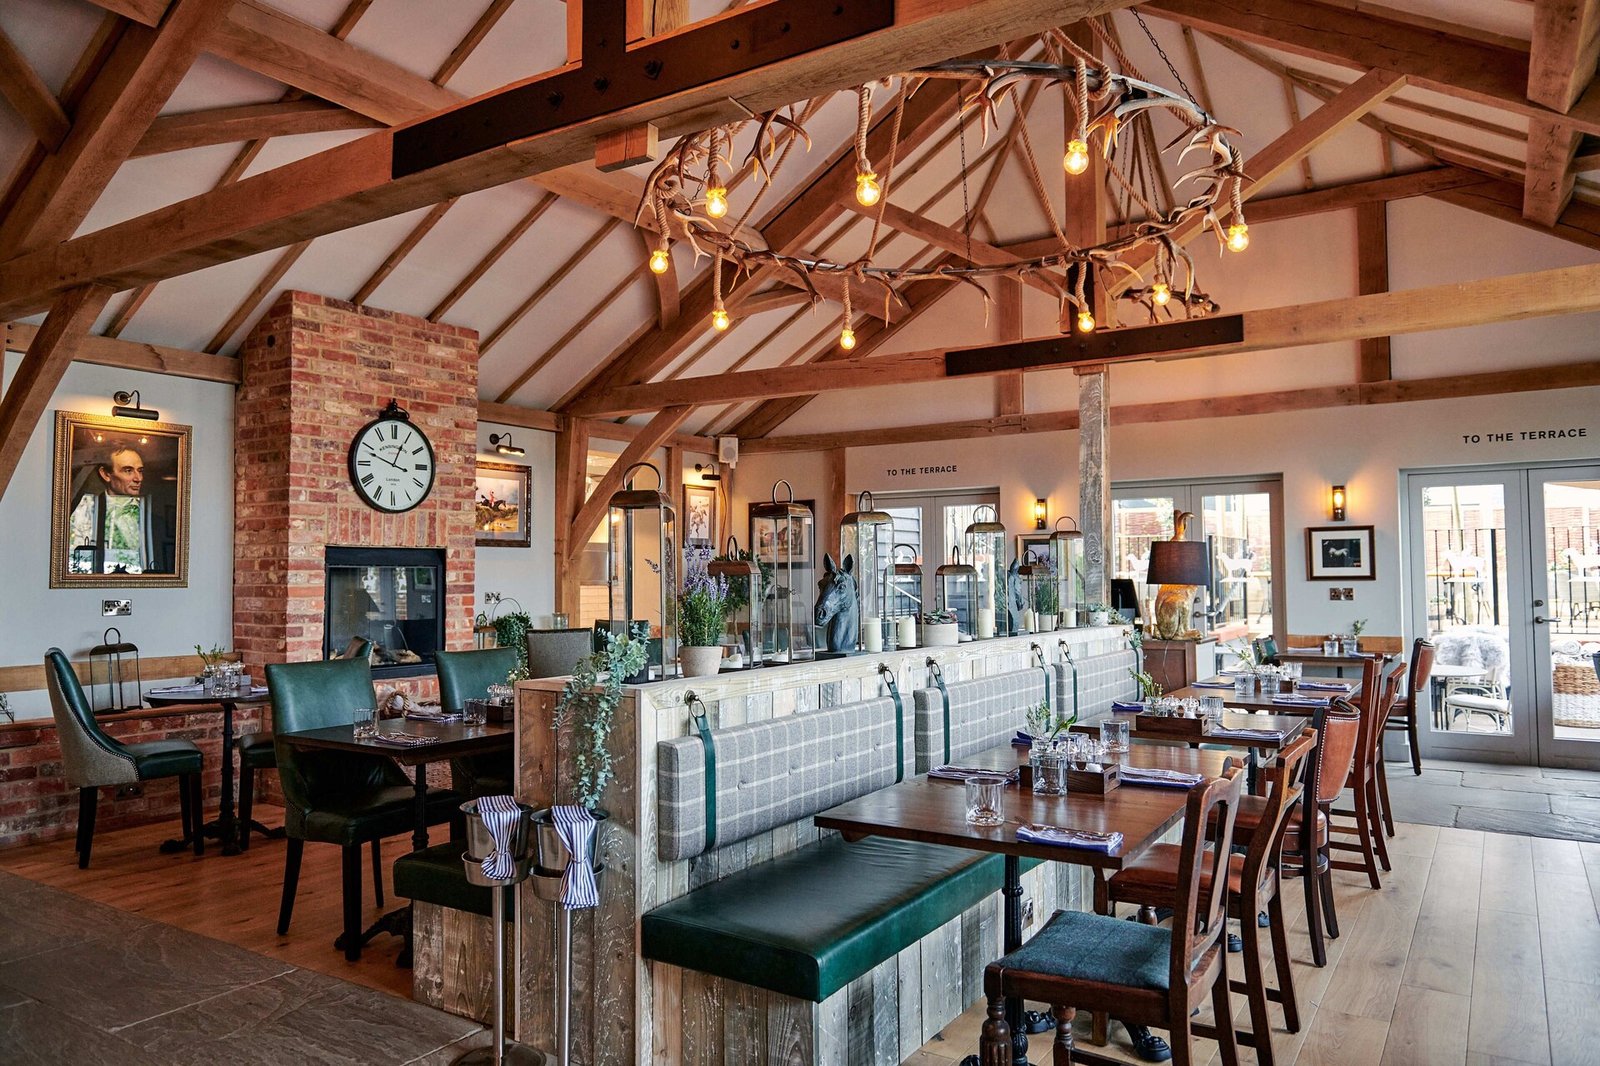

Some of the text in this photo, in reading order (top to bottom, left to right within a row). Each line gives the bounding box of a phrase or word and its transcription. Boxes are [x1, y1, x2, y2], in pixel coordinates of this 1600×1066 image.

[1462, 428, 1588, 444] TO THE TERRACE
[379, 444, 407, 453] KENSINGON
[886, 464, 957, 477] TO THE TERRACE
